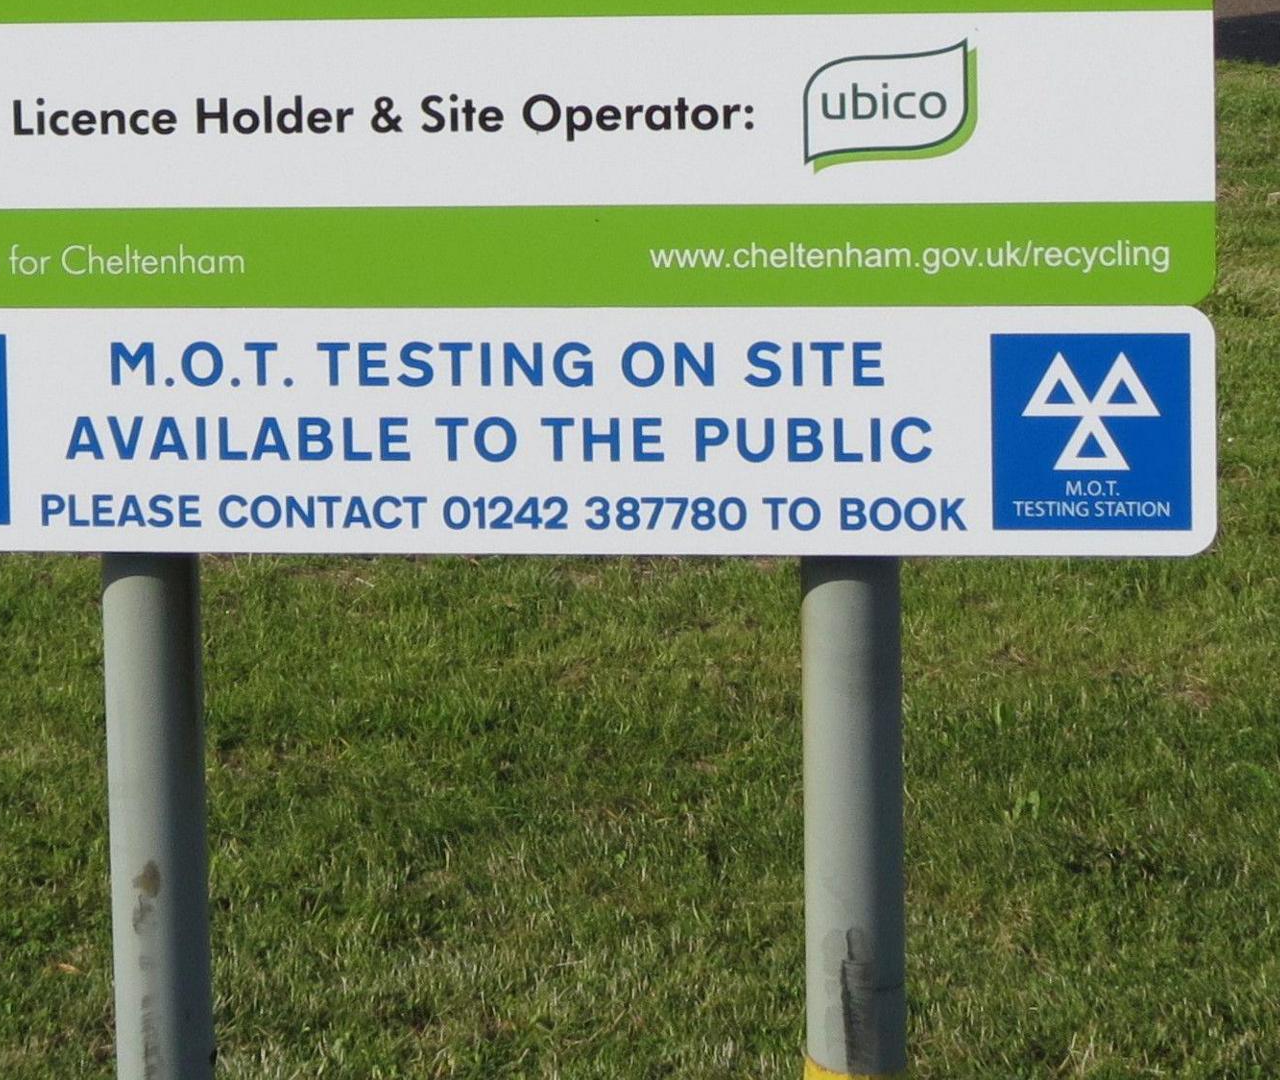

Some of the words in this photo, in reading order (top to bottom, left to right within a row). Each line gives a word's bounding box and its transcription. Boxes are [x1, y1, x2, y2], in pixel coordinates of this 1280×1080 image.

[12, 97, 178, 137] Licence
[196, 94, 354, 135] Holder
[370, 95, 403, 134] &
[420, 93, 504, 134] Site
[522, 93, 754, 142] Operator:
[821, 82, 947, 120] ubico
[8, 243, 52, 276] for
[61, 243, 245, 276] Cheltenham
[649, 239, 1171, 275] www.cheltenham.gov.uk/recycling
[110, 341, 294, 388] M.O.T.
[316, 341, 594, 388] TESTING
[621, 341, 715, 388] ON
[744, 340, 885, 388] SITE
[65, 415, 411, 462] AVAILABLE
[434, 416, 518, 463] TO
[540, 417, 665, 463] THE
[695, 416, 933, 464] PUBLIC
[1065, 480, 1120, 497] M.O.T.
[41, 493, 202, 528] PLEASE
[218, 494, 428, 530] CONTACT
[442, 495, 569, 531] 01242
[585, 495, 748, 532] 387780
[762, 496, 822, 532] TO
[839, 496, 967, 532] BOOK
[1012, 500, 1090, 518] TESTING
[1094, 500, 1171, 518] STATION
